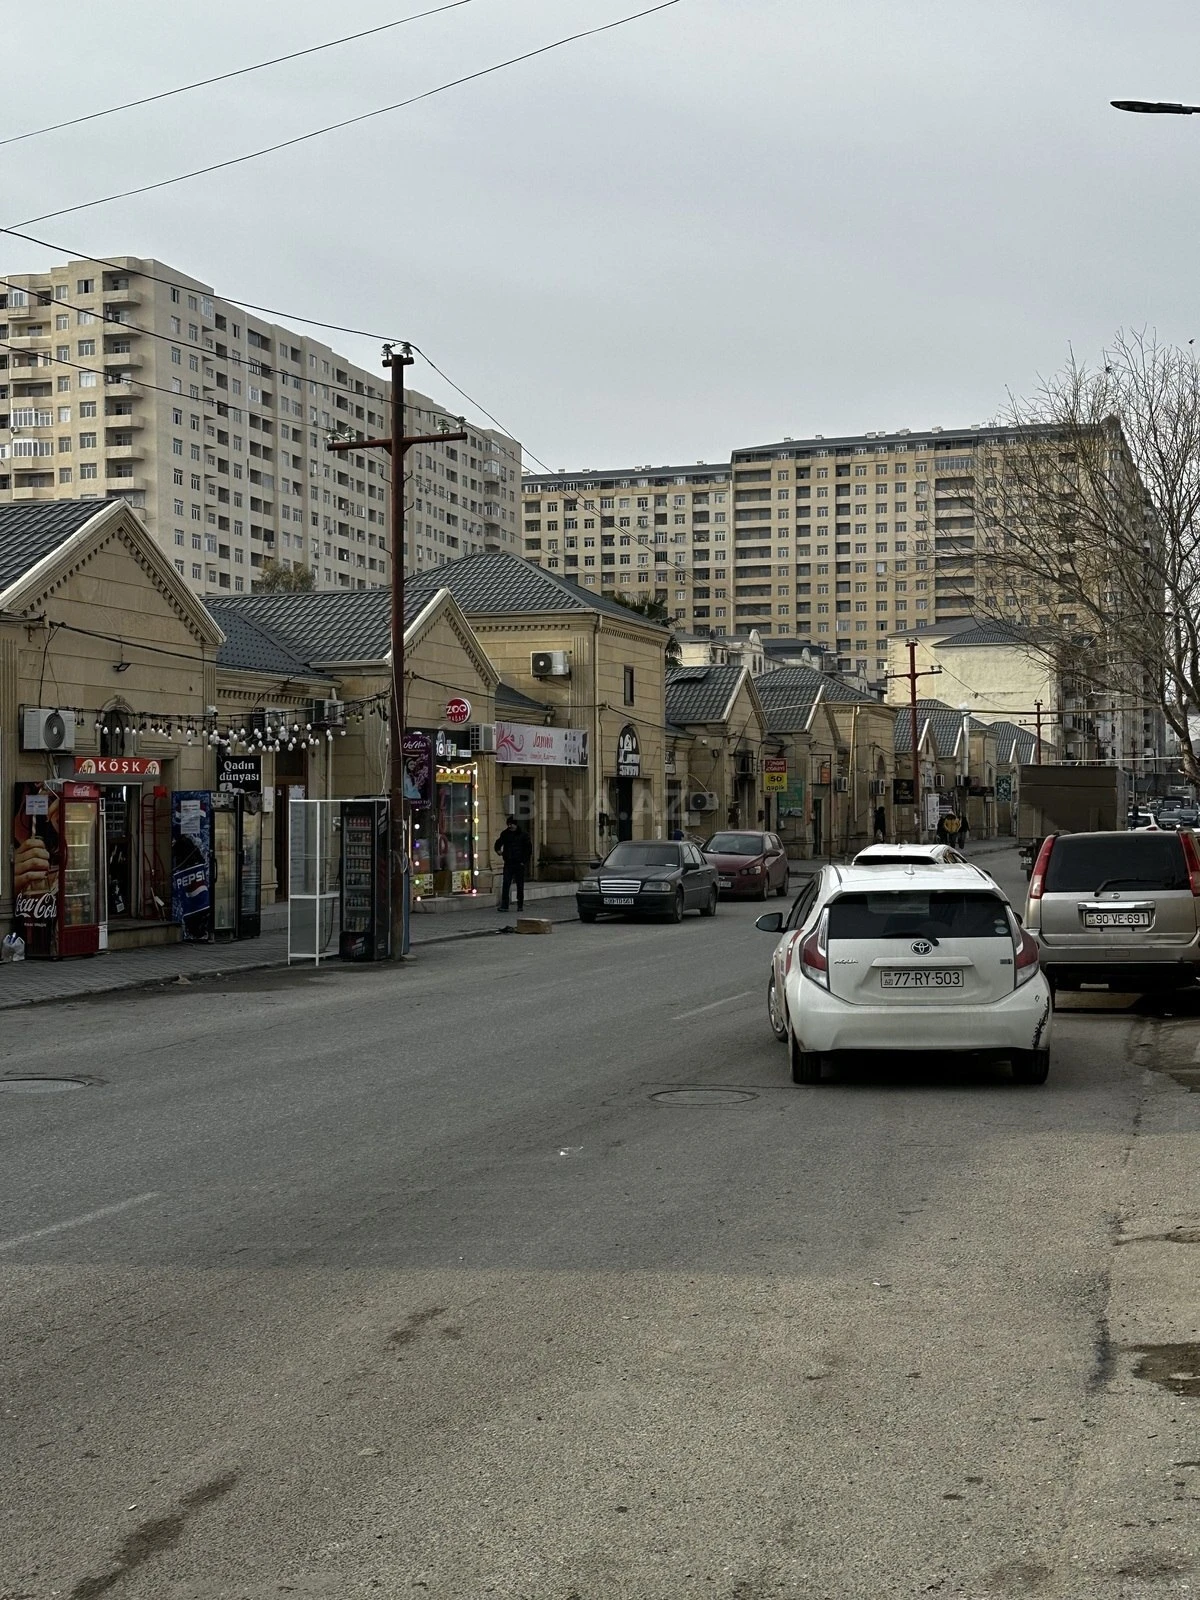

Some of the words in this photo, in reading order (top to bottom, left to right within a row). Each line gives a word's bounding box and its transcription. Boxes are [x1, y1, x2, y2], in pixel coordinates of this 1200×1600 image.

[445, 703, 467, 714] ZOO
[98, 758, 140, 774] KÖŞK
[223, 760, 255, 772] Qadın
[219, 772, 259, 784] dünyası
[176, 869, 206, 889] PEPSI
[1096, 913, 1146, 924] 90-VE-691
[894, 971, 960, 986] 77-RY-503
